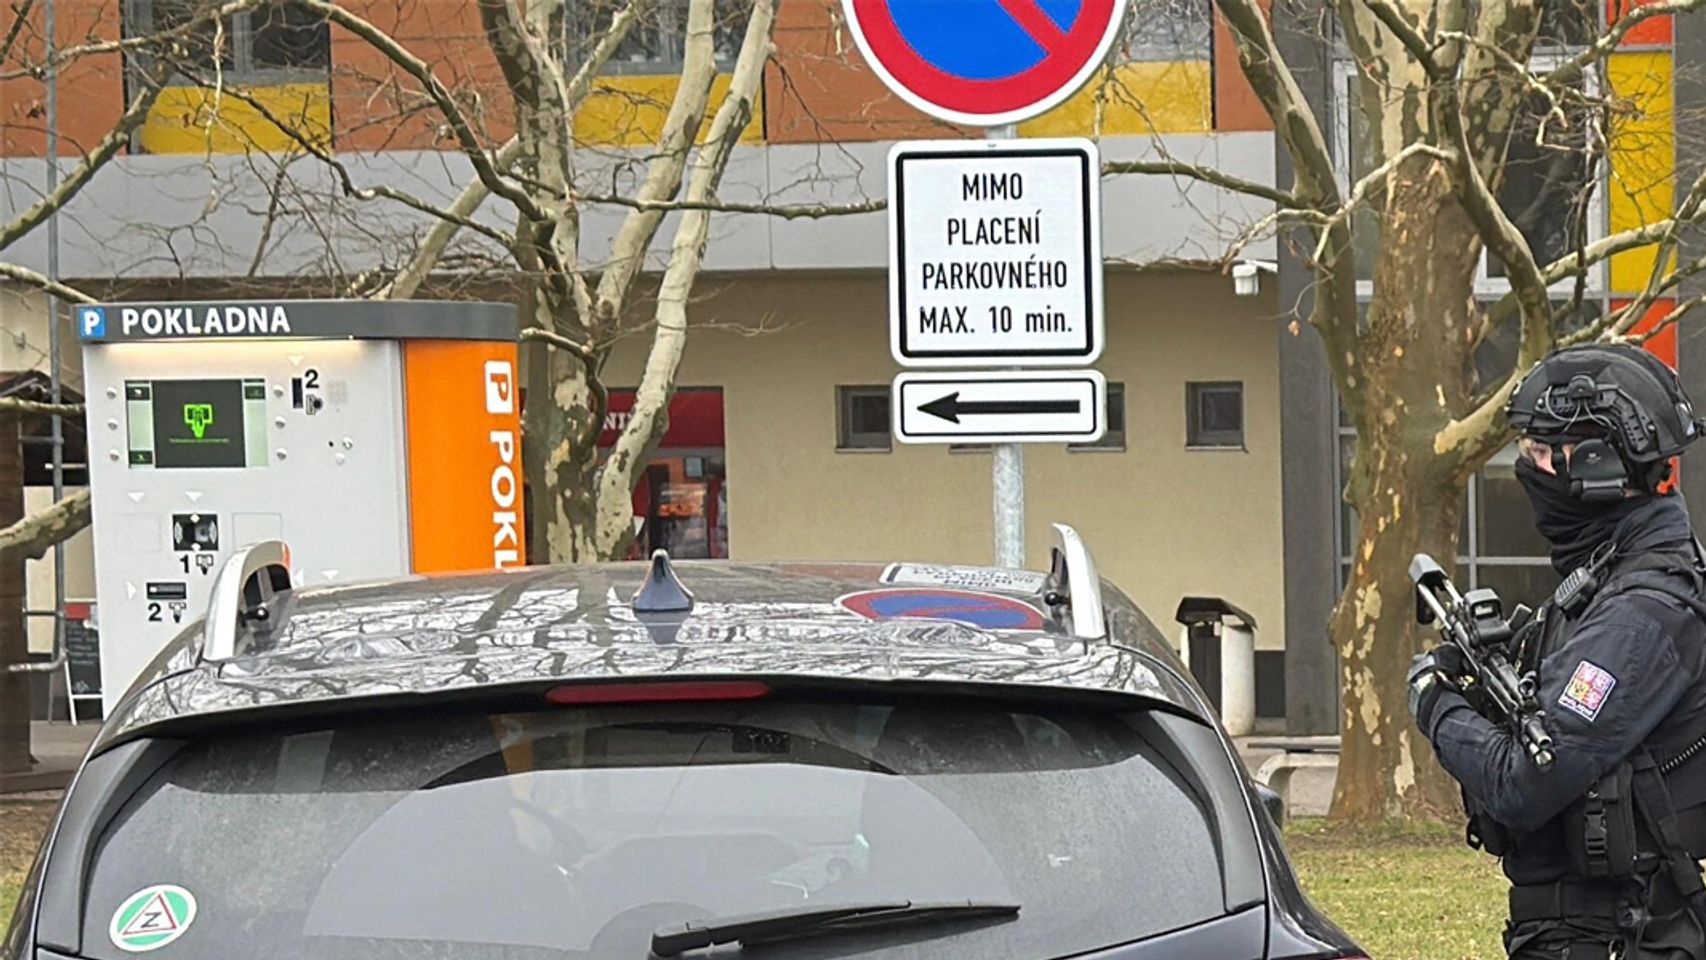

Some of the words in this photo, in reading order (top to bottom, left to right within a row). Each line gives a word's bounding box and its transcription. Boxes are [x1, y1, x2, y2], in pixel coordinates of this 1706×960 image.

[961, 172, 1023, 201] MIMO
[947, 209, 1041, 246] PLACENÍ
[922, 254, 1068, 290] PARKOVNÉHO
[121, 306, 291, 335] POKLADNA
[919, 305, 975, 335] MAX.
[988, 306, 1012, 334] 10
[1025, 305, 1073, 333] min.
[304, 368, 320, 389] 2
[179, 554, 190, 574] 1
[147, 602, 163, 622] 2
